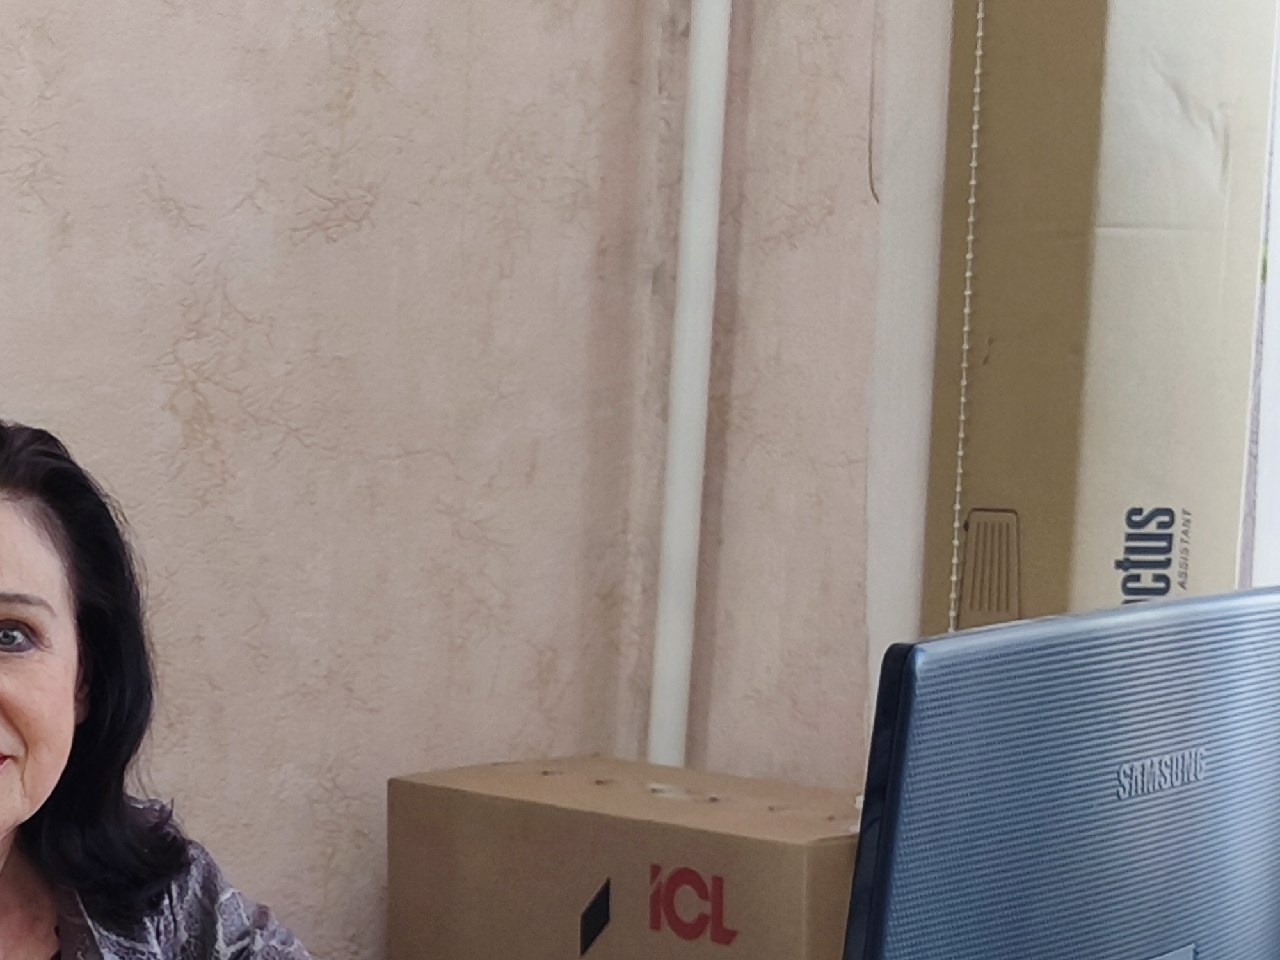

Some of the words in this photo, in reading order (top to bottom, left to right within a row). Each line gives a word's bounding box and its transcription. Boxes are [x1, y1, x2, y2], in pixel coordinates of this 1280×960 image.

[1114, 506, 1175, 604] ctus
[1177, 507, 1192, 591] ASSISTANT
[1117, 748, 1206, 800] SAMSUNG
